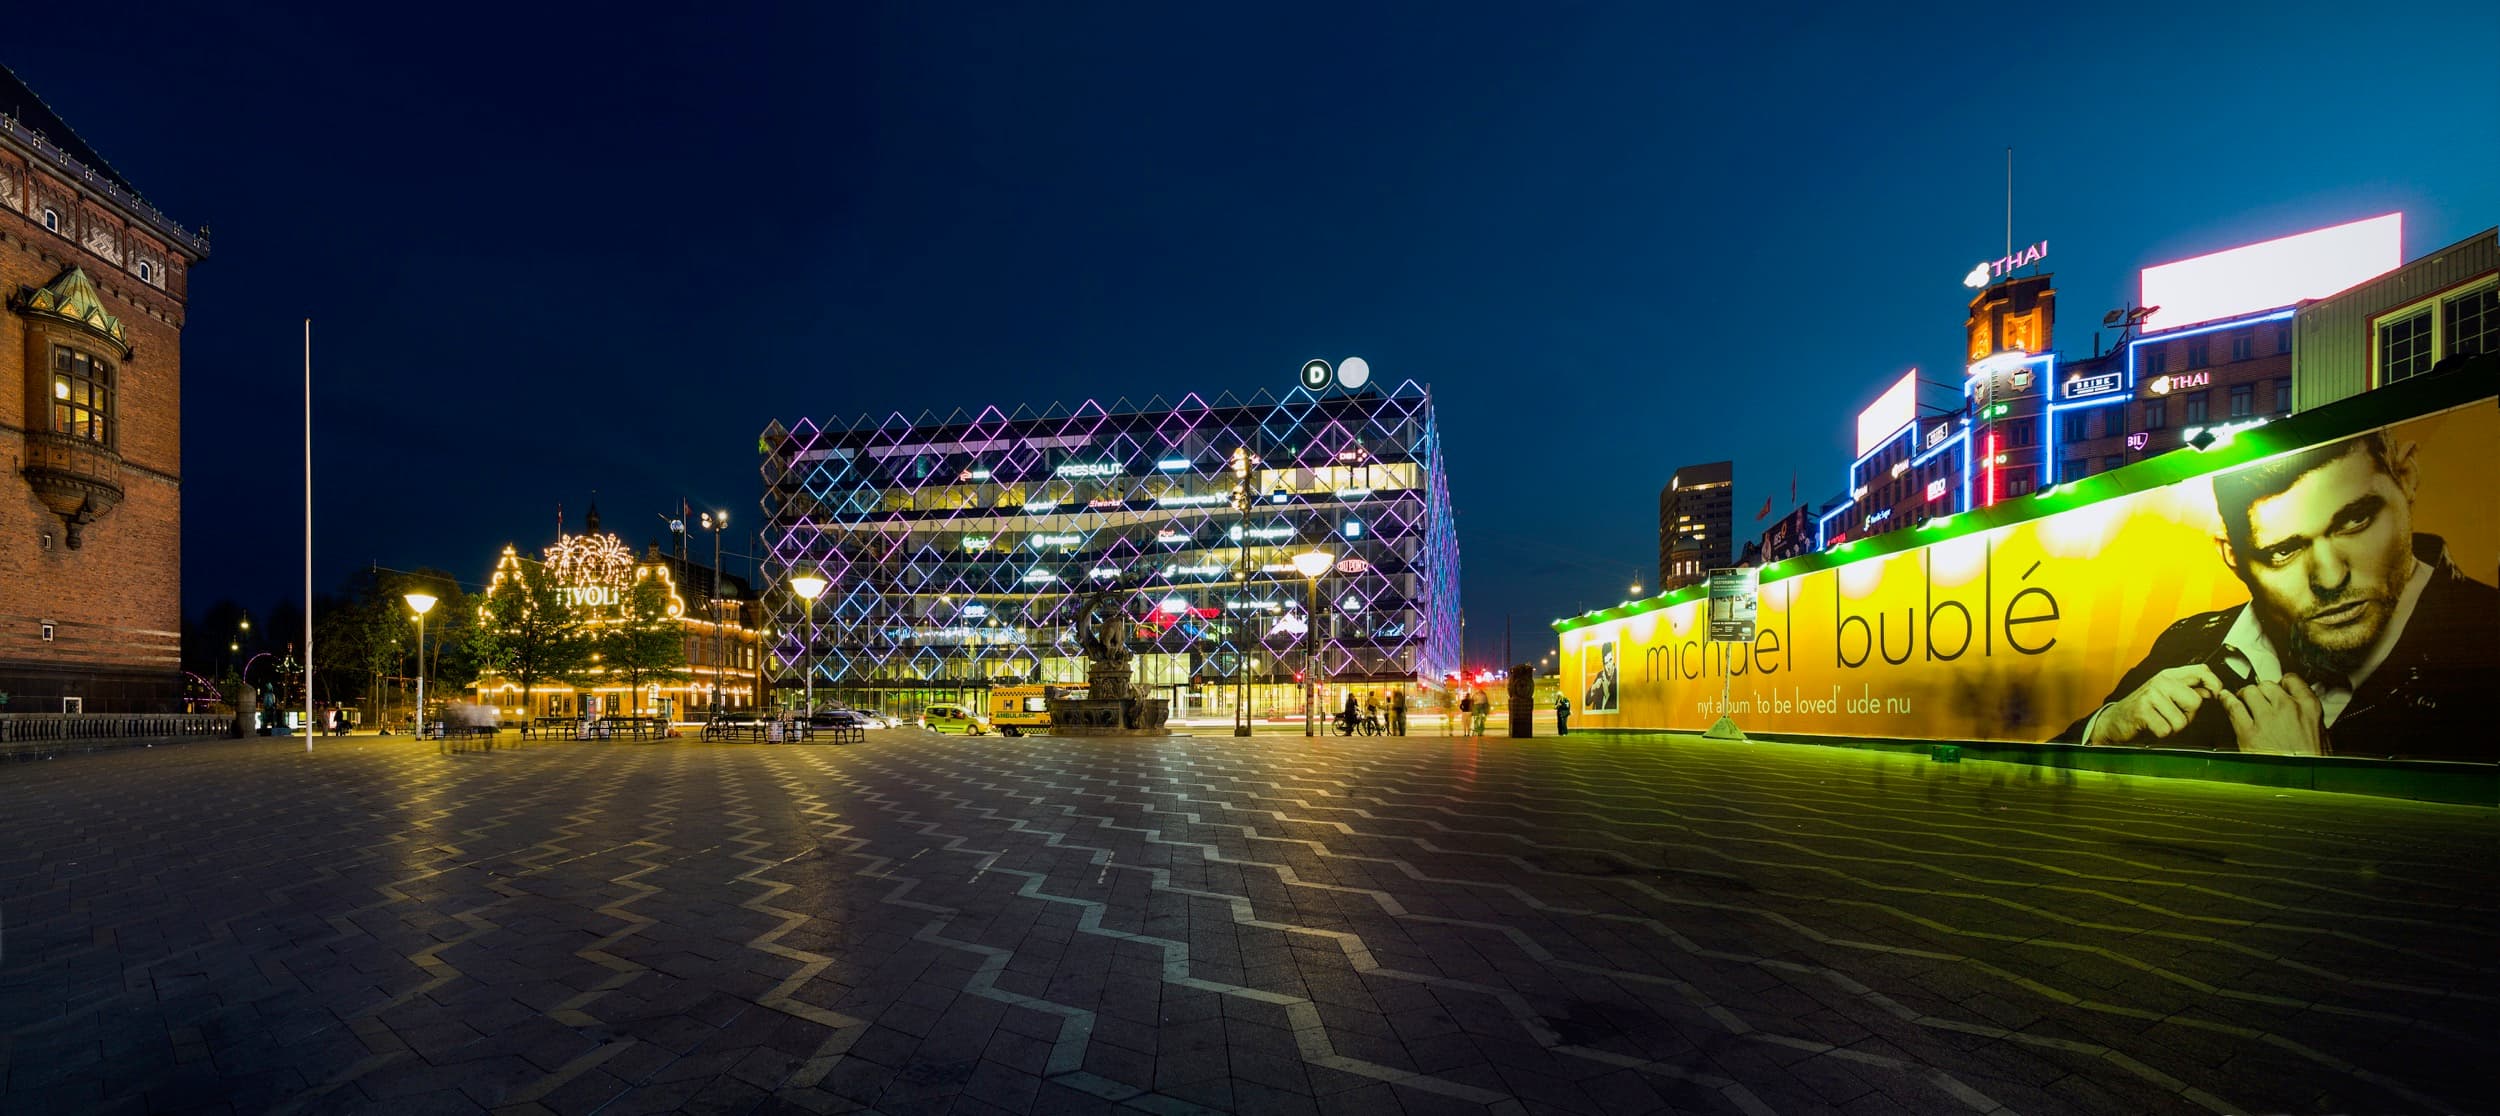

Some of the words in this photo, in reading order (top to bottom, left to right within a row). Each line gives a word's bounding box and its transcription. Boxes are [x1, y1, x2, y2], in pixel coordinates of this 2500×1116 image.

[1990, 240, 2047, 277] THAI
[1310, 366, 1325, 384] D
[2170, 372, 2210, 390] THAI
[555, 585, 619, 606] TIVOLI
[1836, 535, 2060, 668] bublé
[1697, 695, 1713, 719] nyt
[1774, 687, 1791, 714] be
[1846, 683, 1881, 714] ude
[1887, 696, 1911, 714] nu
